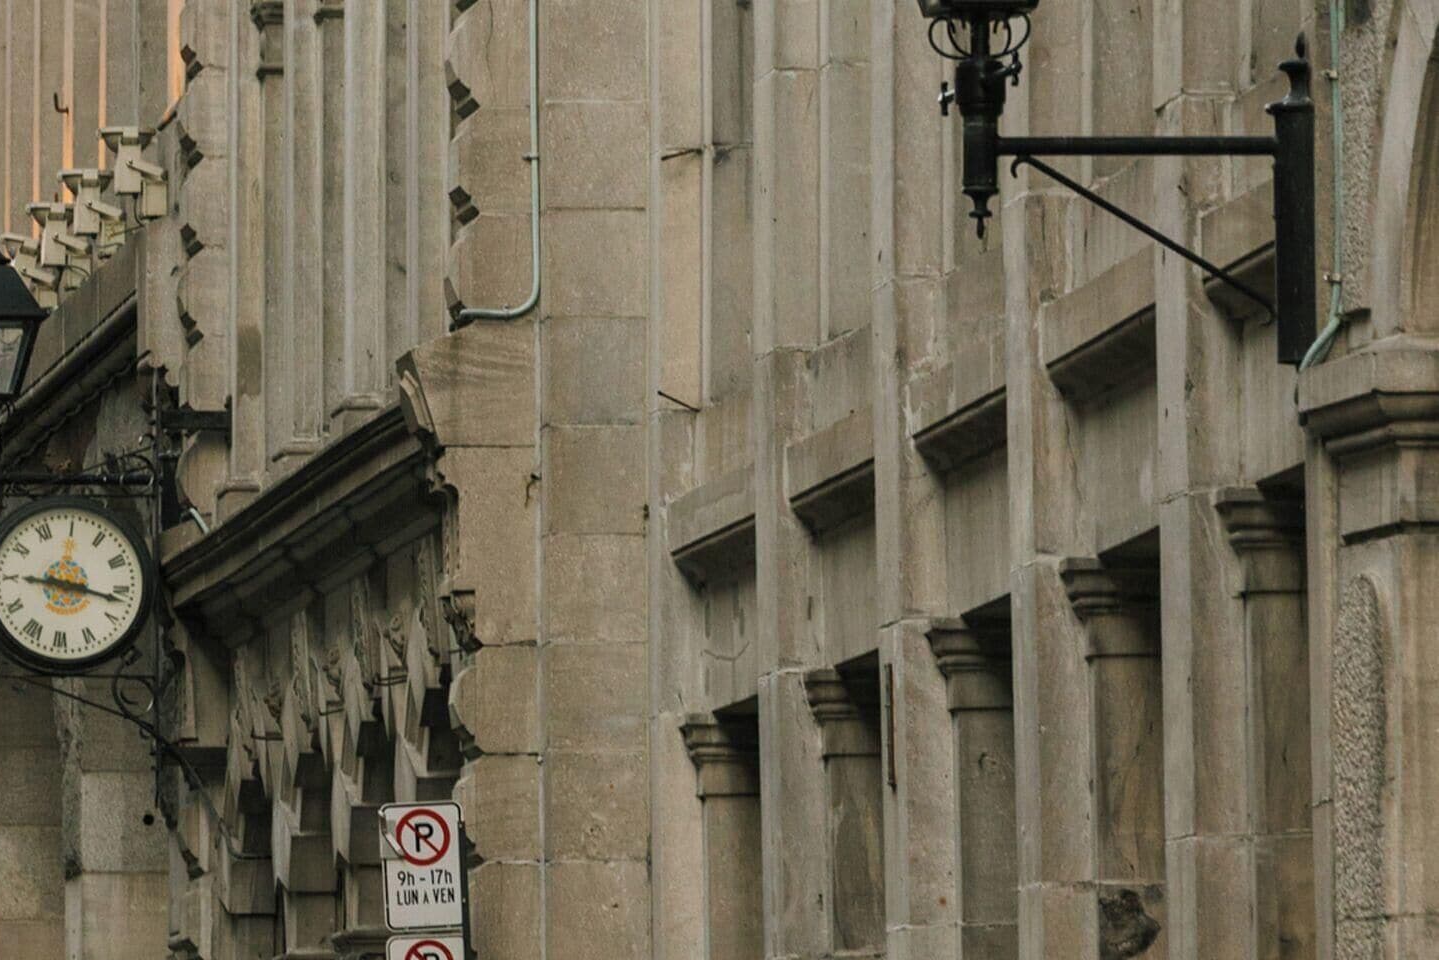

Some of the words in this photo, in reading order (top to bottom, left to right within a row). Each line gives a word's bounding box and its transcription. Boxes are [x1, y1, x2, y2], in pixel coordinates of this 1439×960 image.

[69, 520, 74, 537] I
[92, 531, 106, 548] II
[12, 542, 30, 559] XI
[108, 554, 126, 569] III
[2, 573, 19, 583] X
[104, 612, 119, 625] V
[53, 631, 67, 648] VII
[81, 626, 96, 644] VI
[397, 870, 415, 887] 9h
[430, 869, 453, 885] 17h
[397, 889, 419, 906] LUN
[433, 887, 455, 904] VEN
